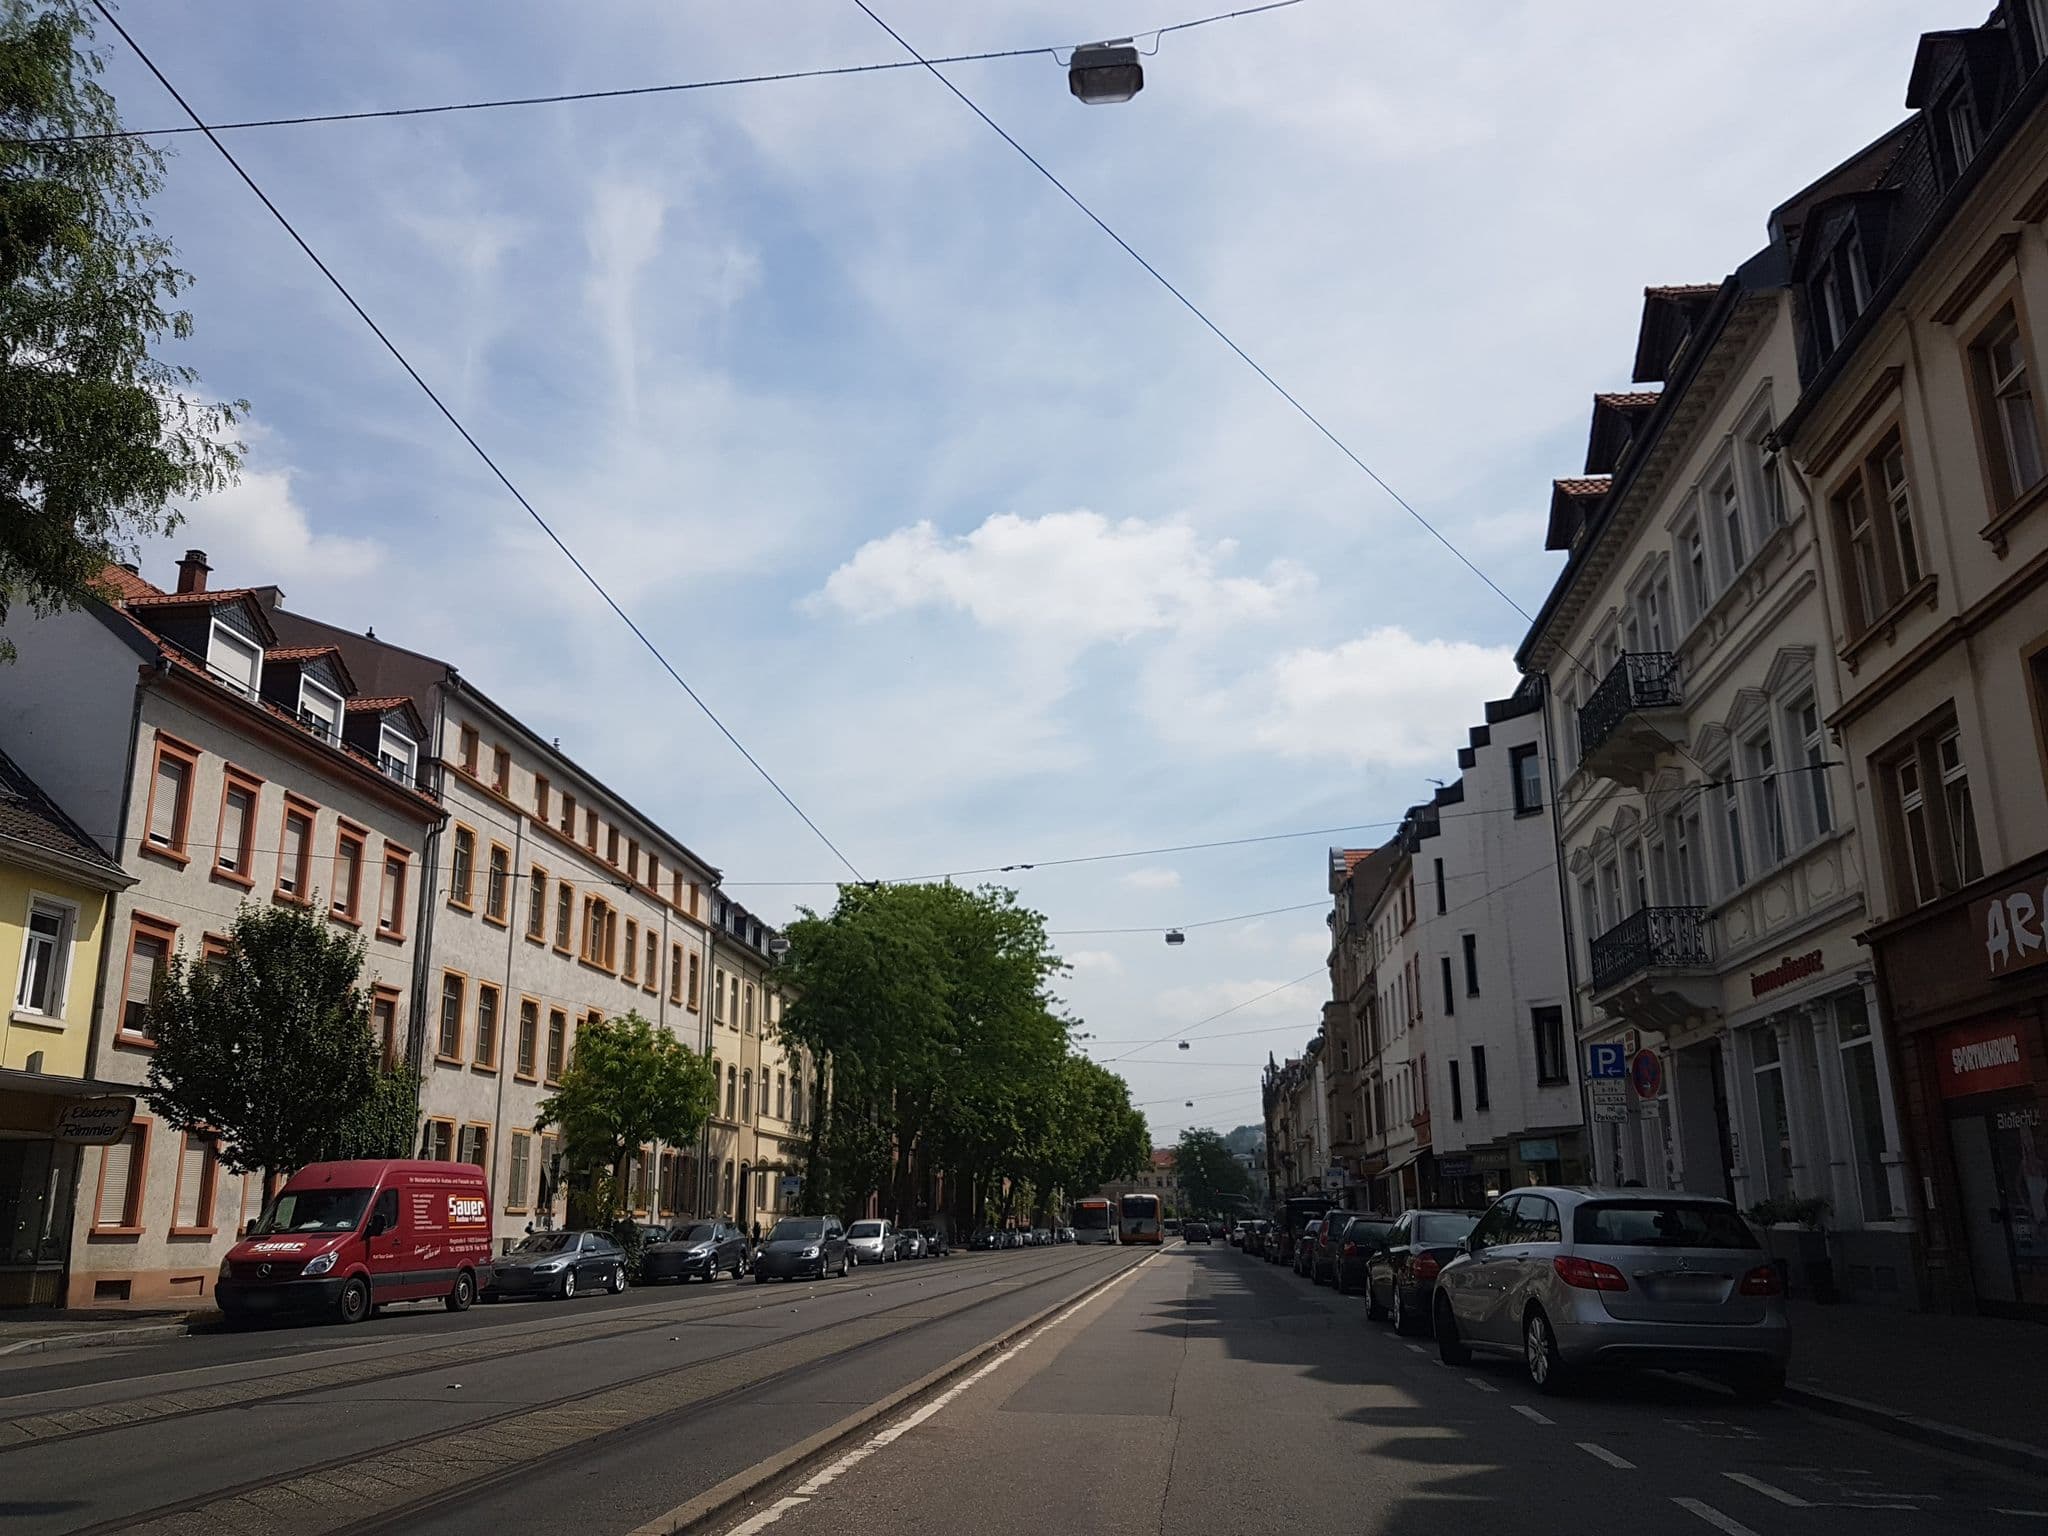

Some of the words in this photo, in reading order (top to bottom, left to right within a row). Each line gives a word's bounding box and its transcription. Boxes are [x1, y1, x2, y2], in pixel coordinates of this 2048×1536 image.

[1986, 880, 2048, 974] AR
[1598, 1048, 1616, 1075] P
[1952, 1034, 2020, 1074] SPORTNAHRUNG
[449, 1197, 484, 1216] Sauer
